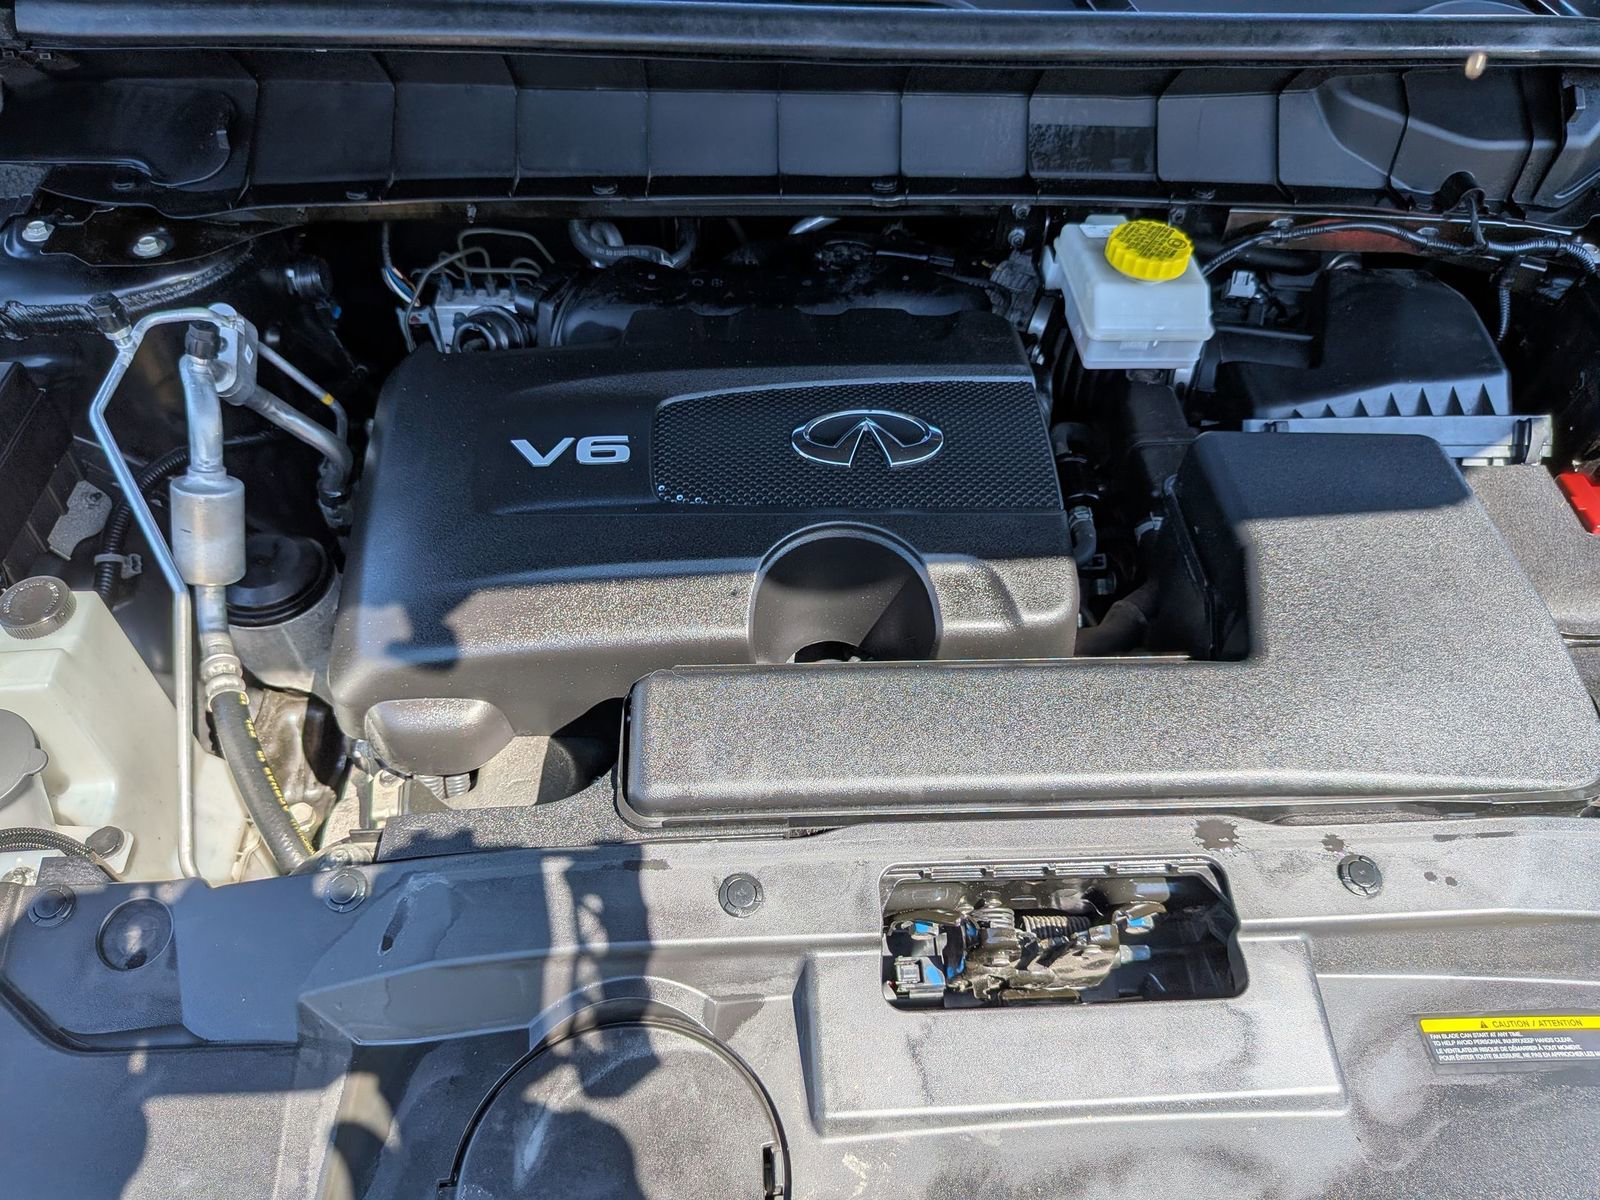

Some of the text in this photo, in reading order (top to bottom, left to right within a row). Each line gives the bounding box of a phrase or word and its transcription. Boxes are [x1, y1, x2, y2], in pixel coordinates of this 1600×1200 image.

[510, 435, 630, 467] V6
[1492, 1020, 1529, 1028] CAUTION
[1539, 1019, 1583, 1027] ATTENTION
